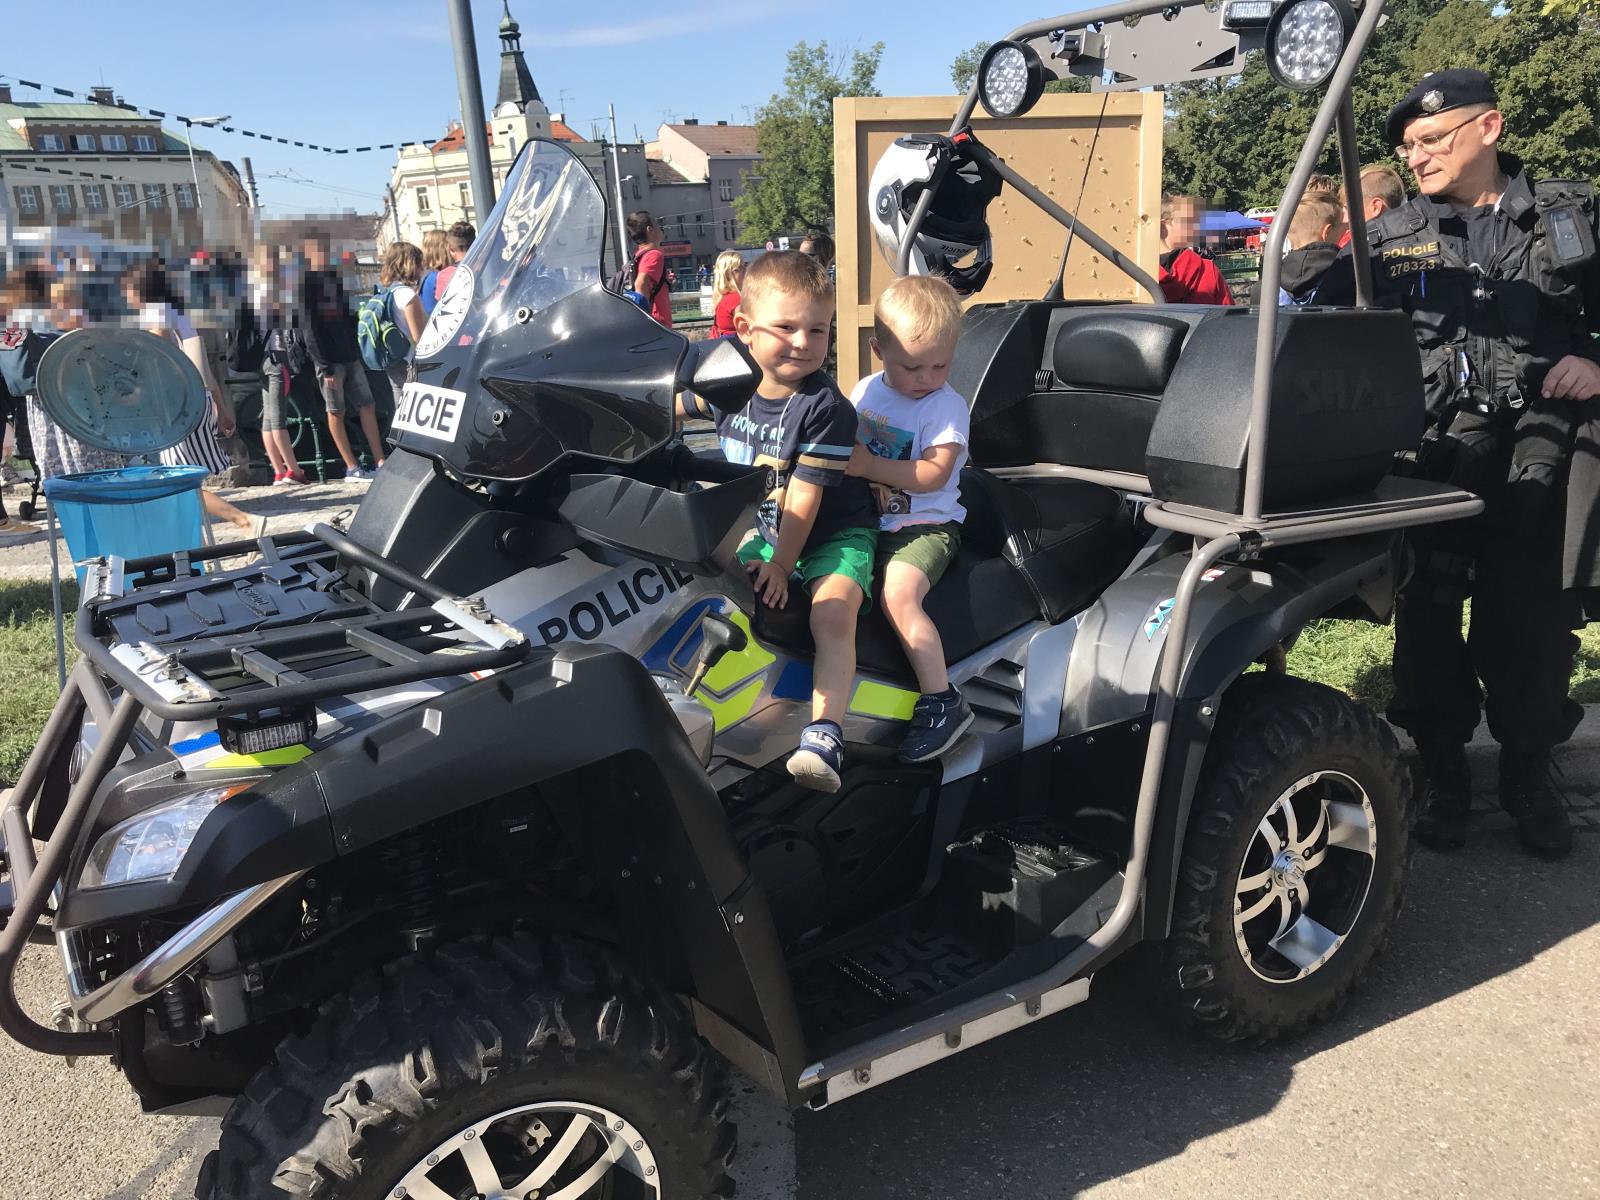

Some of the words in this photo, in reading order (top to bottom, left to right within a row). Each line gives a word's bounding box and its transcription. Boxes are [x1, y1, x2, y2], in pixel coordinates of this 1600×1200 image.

[1382, 241, 1438, 261] POLICIE
[1390, 260, 1436, 277] 278323
[415, 297, 468, 353] EPUBLIKY
[730, 414, 759, 436] HOW
